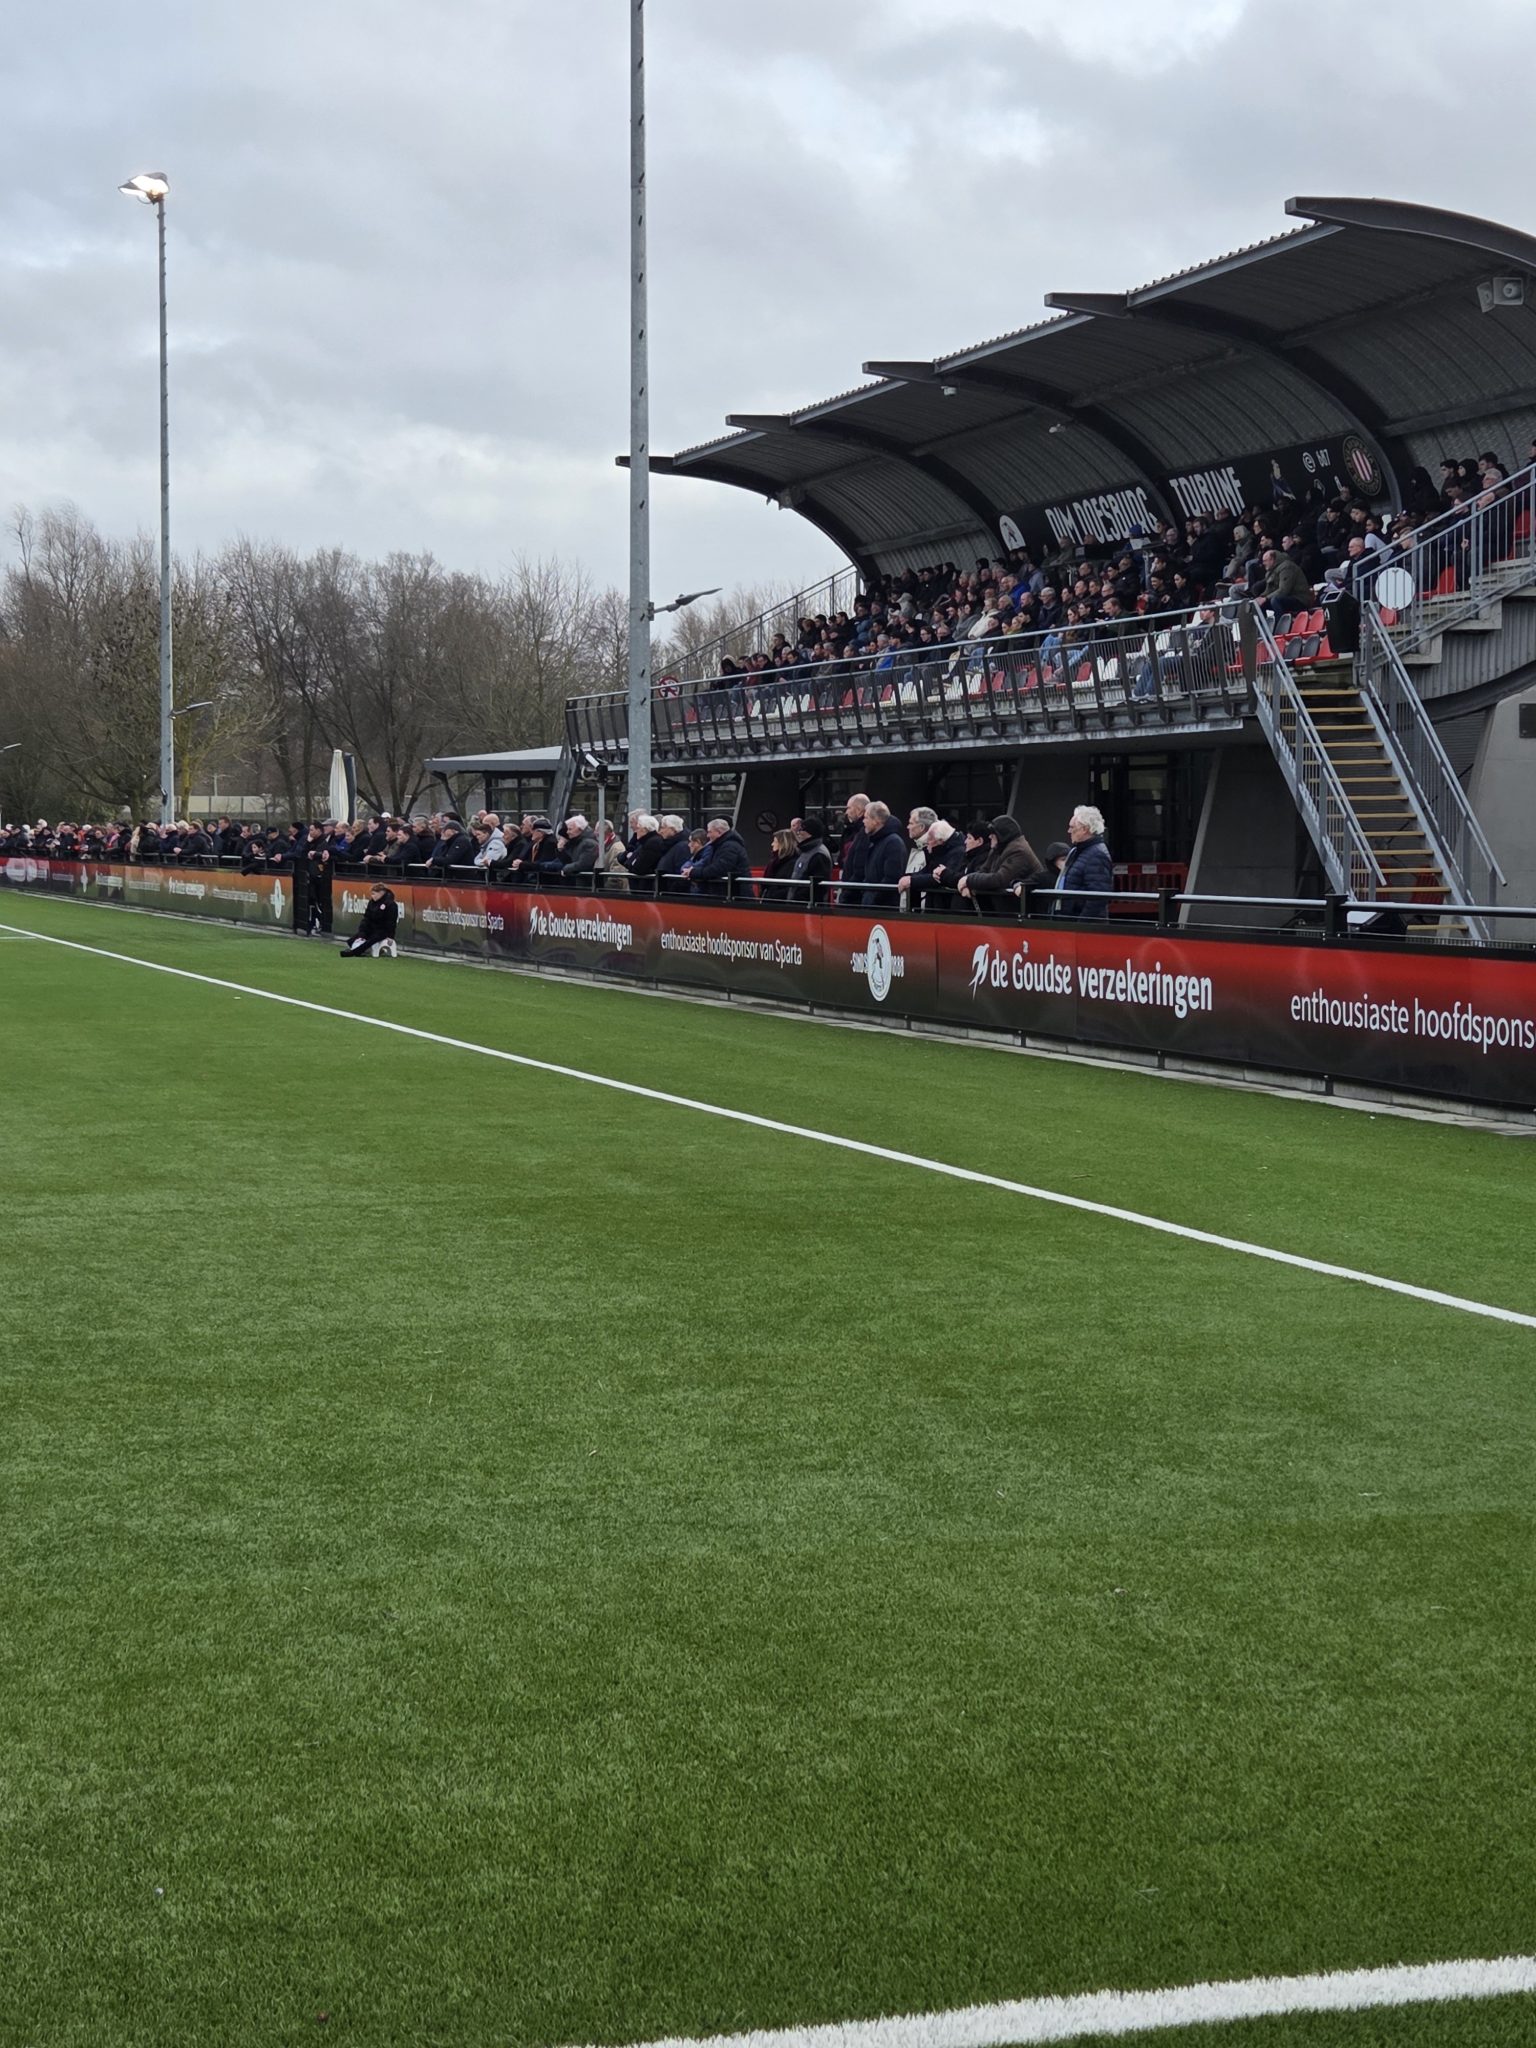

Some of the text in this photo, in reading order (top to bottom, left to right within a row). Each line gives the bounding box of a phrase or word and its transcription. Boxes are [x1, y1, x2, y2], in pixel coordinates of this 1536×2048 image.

[538, 910, 632, 951] de Goudse verzekeringen
[661, 928, 802, 969] enthousiaste hoofdsponsor van Sparta
[991, 950, 1212, 1019] de Goudse verzekeringen
[1291, 987, 1536, 1055] enthousiaste hoofdspons
